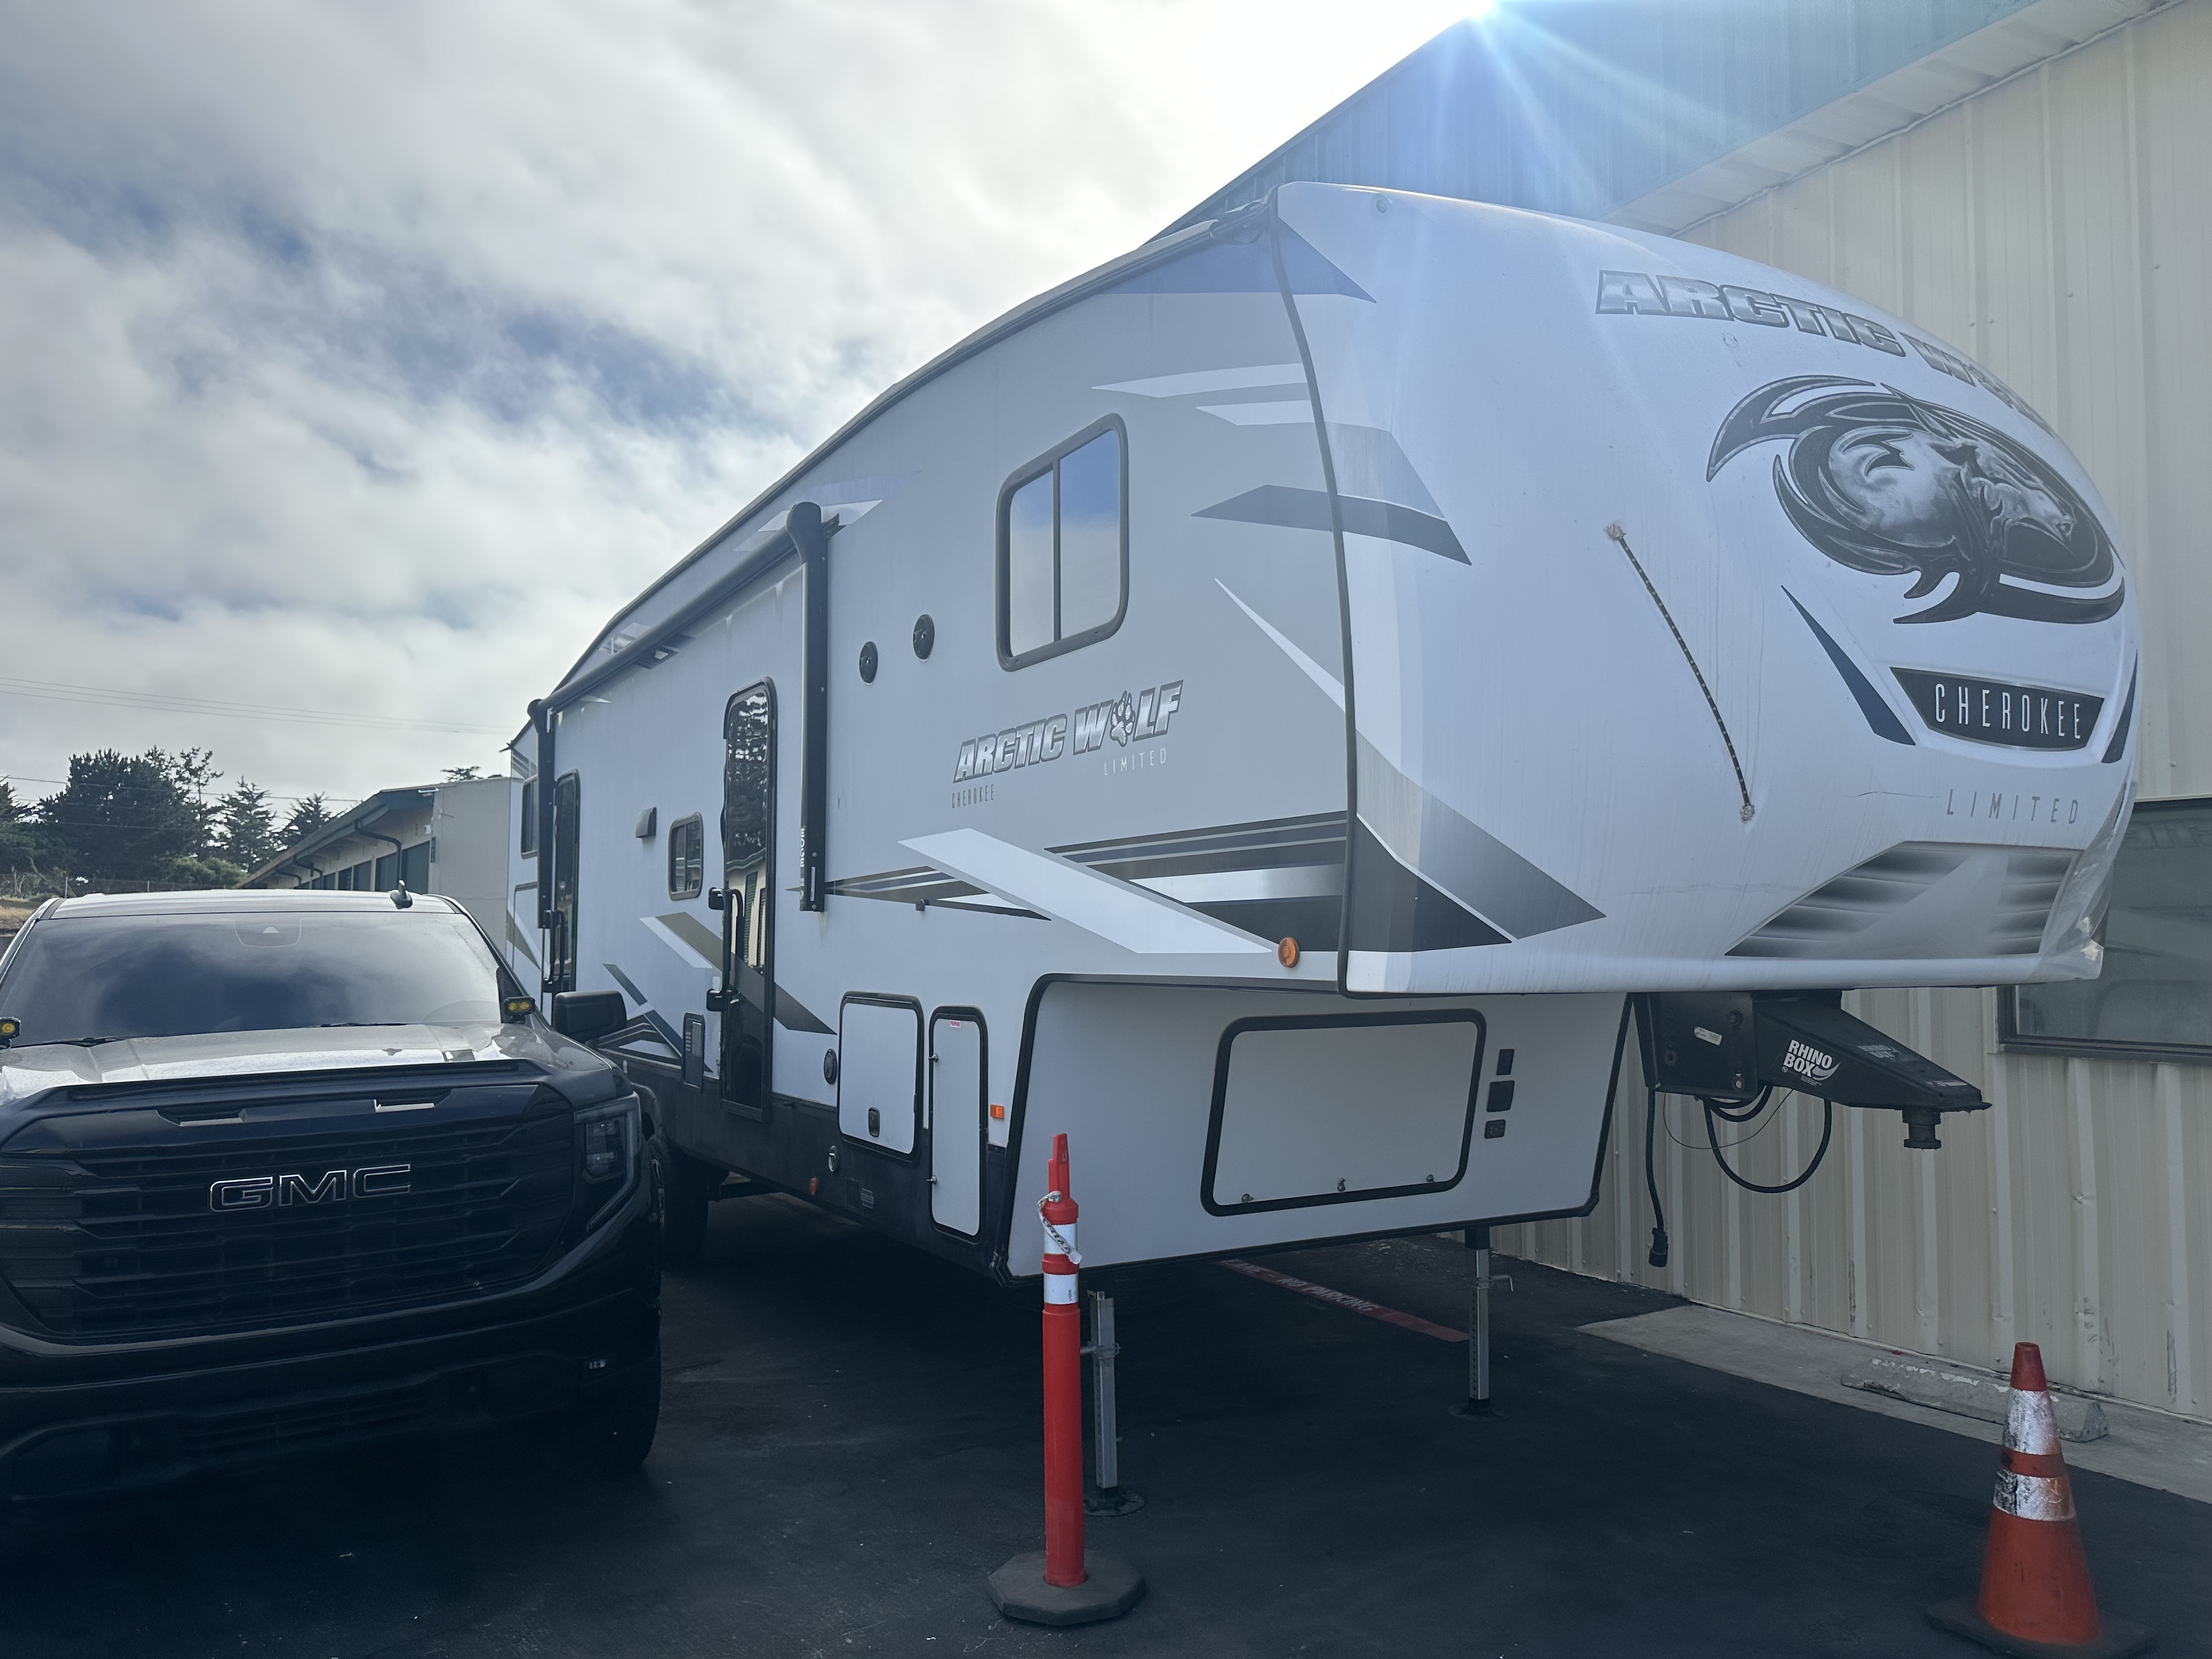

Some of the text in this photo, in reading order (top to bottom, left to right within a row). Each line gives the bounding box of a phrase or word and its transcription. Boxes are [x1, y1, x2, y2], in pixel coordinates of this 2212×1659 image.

[1596, 269, 1906, 357] ARCTIC
[1935, 684, 2081, 739] CHEROKEE
[953, 714, 1067, 783] ARCTIC
[1104, 748, 1167, 776] LIMITED
[952, 784, 995, 809] CHEROKEE
[1946, 789, 2079, 824] LIMITED
[1783, 1052, 1815, 1077] BOX
[1788, 1040, 1832, 1069] RHINO
[210, 1163, 411, 1212] GMC
[1301, 1286, 1380, 1311] PARKING
